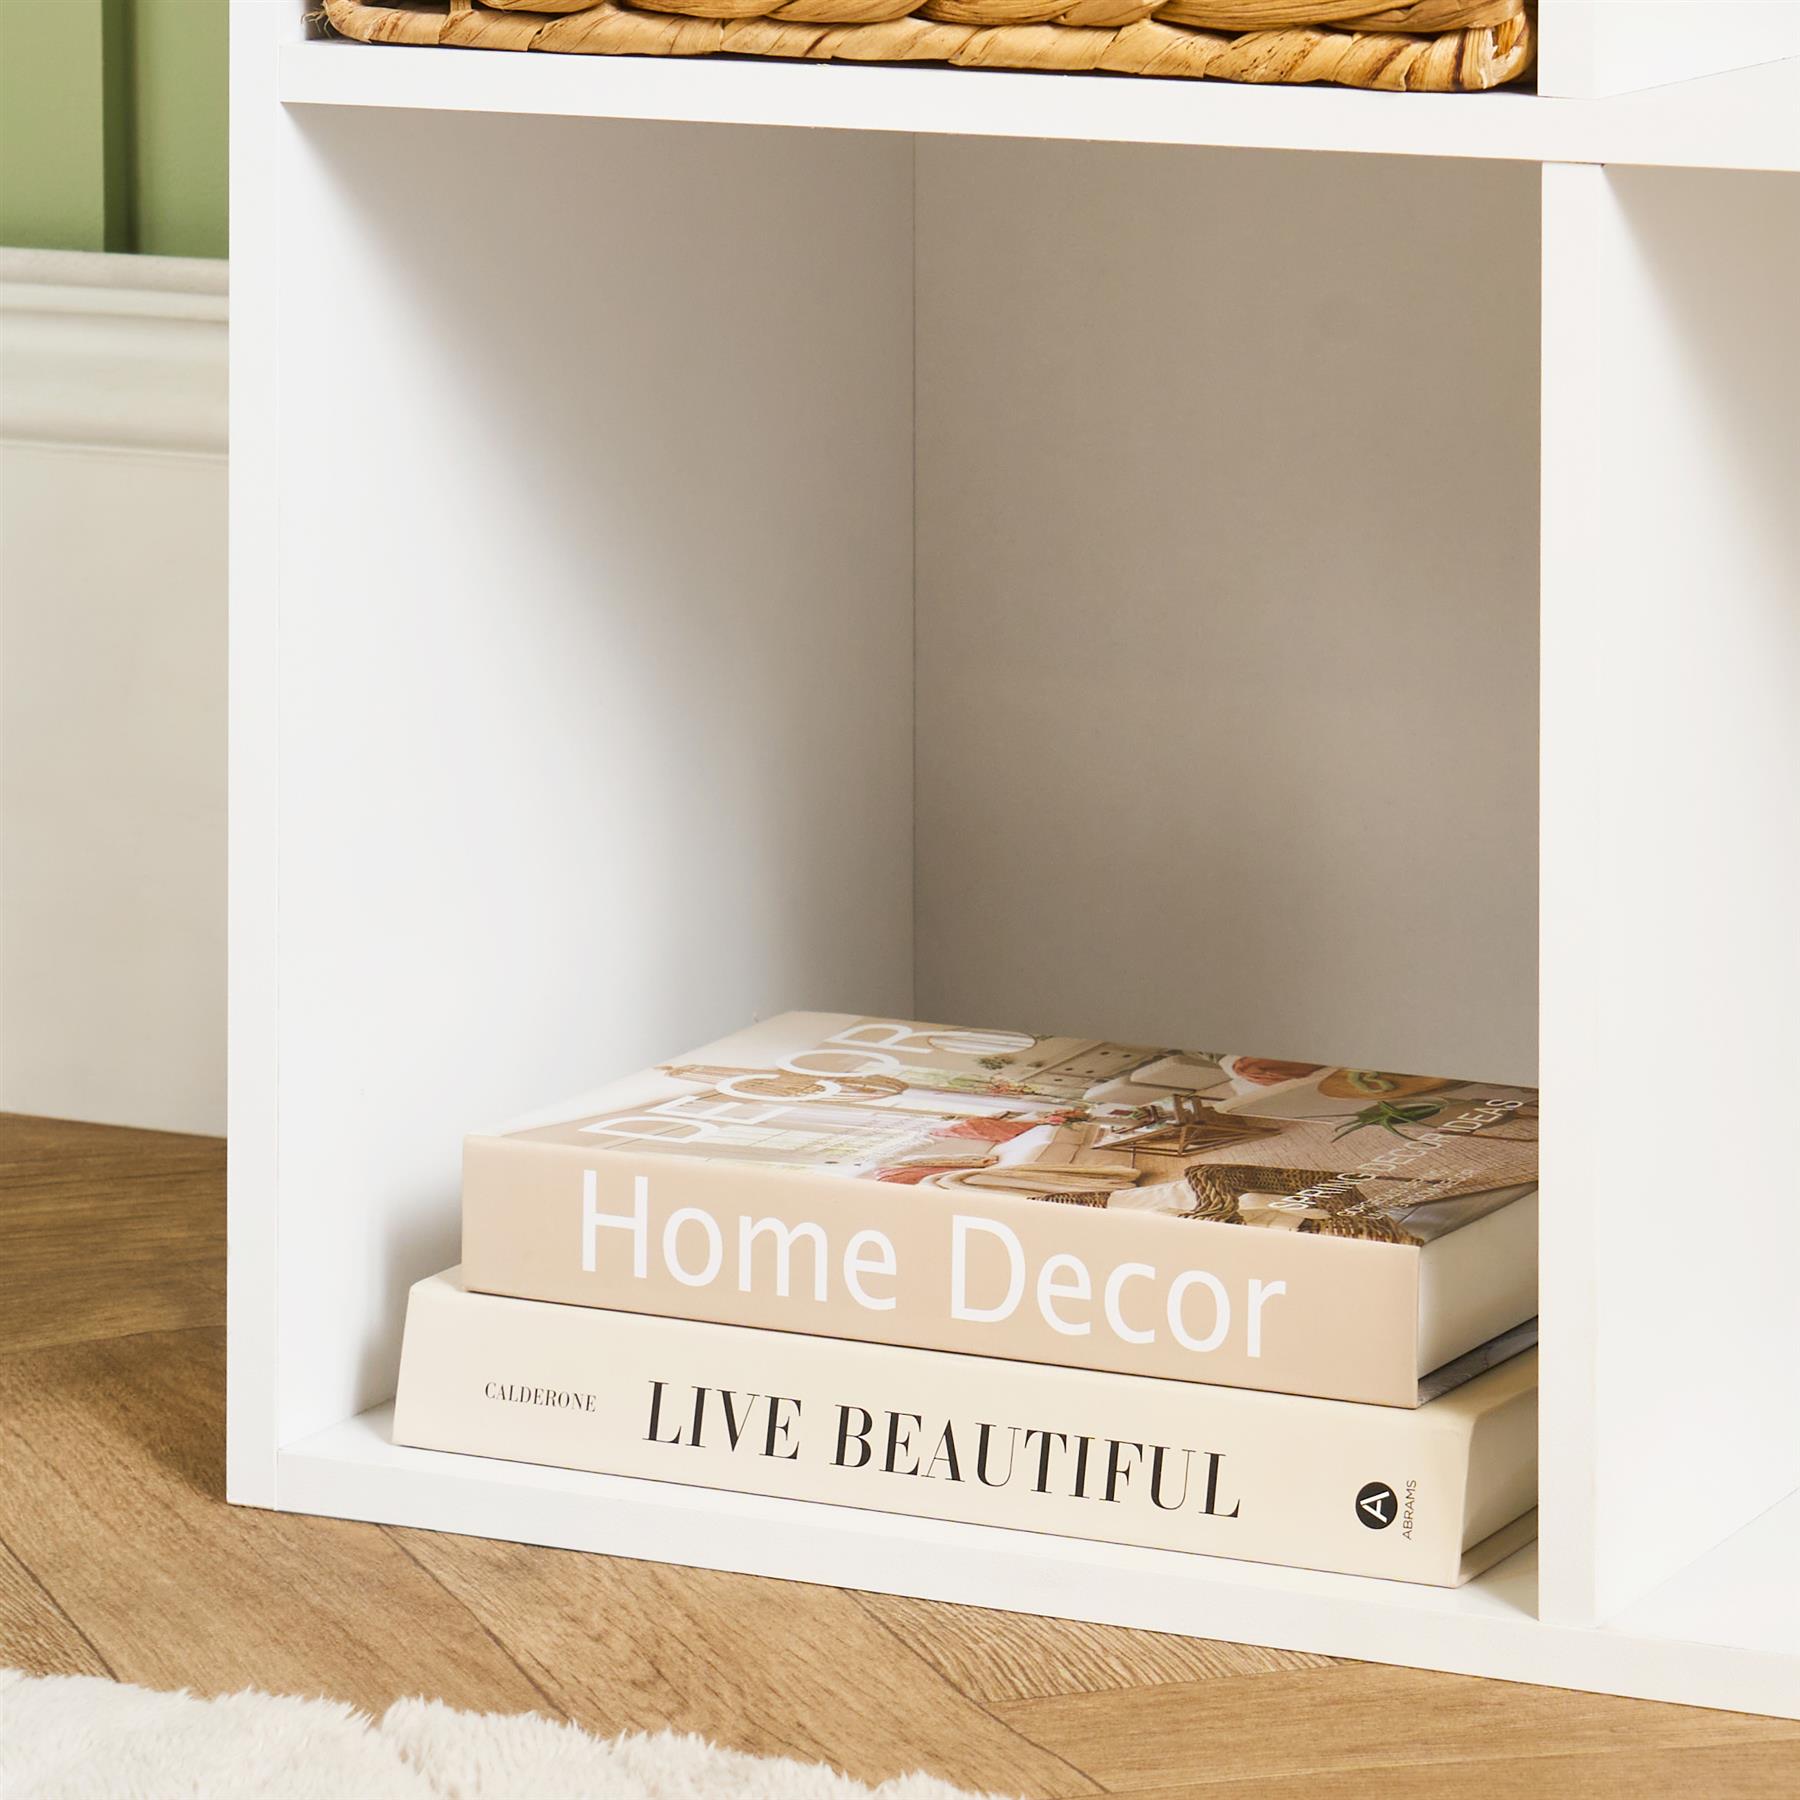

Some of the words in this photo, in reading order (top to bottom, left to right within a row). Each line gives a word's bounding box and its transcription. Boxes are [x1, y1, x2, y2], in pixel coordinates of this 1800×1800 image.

[577, 1022, 986, 1145] DECOR
[1268, 1171, 1377, 1211] SPRING
[1356, 1131, 1450, 1173] DECOR
[1441, 1097, 1524, 1134] IDEAS
[580, 1169, 898, 1311] Home
[950, 1214, 1287, 1358] Decor
[484, 1381, 597, 1413] CALDERONE
[641, 1379, 802, 1461] LIVE
[828, 1403, 1241, 1519] BEAUTIFUL
[1359, 1490, 1391, 1524] A
[1402, 1479, 1417, 1541] ABRAMS
